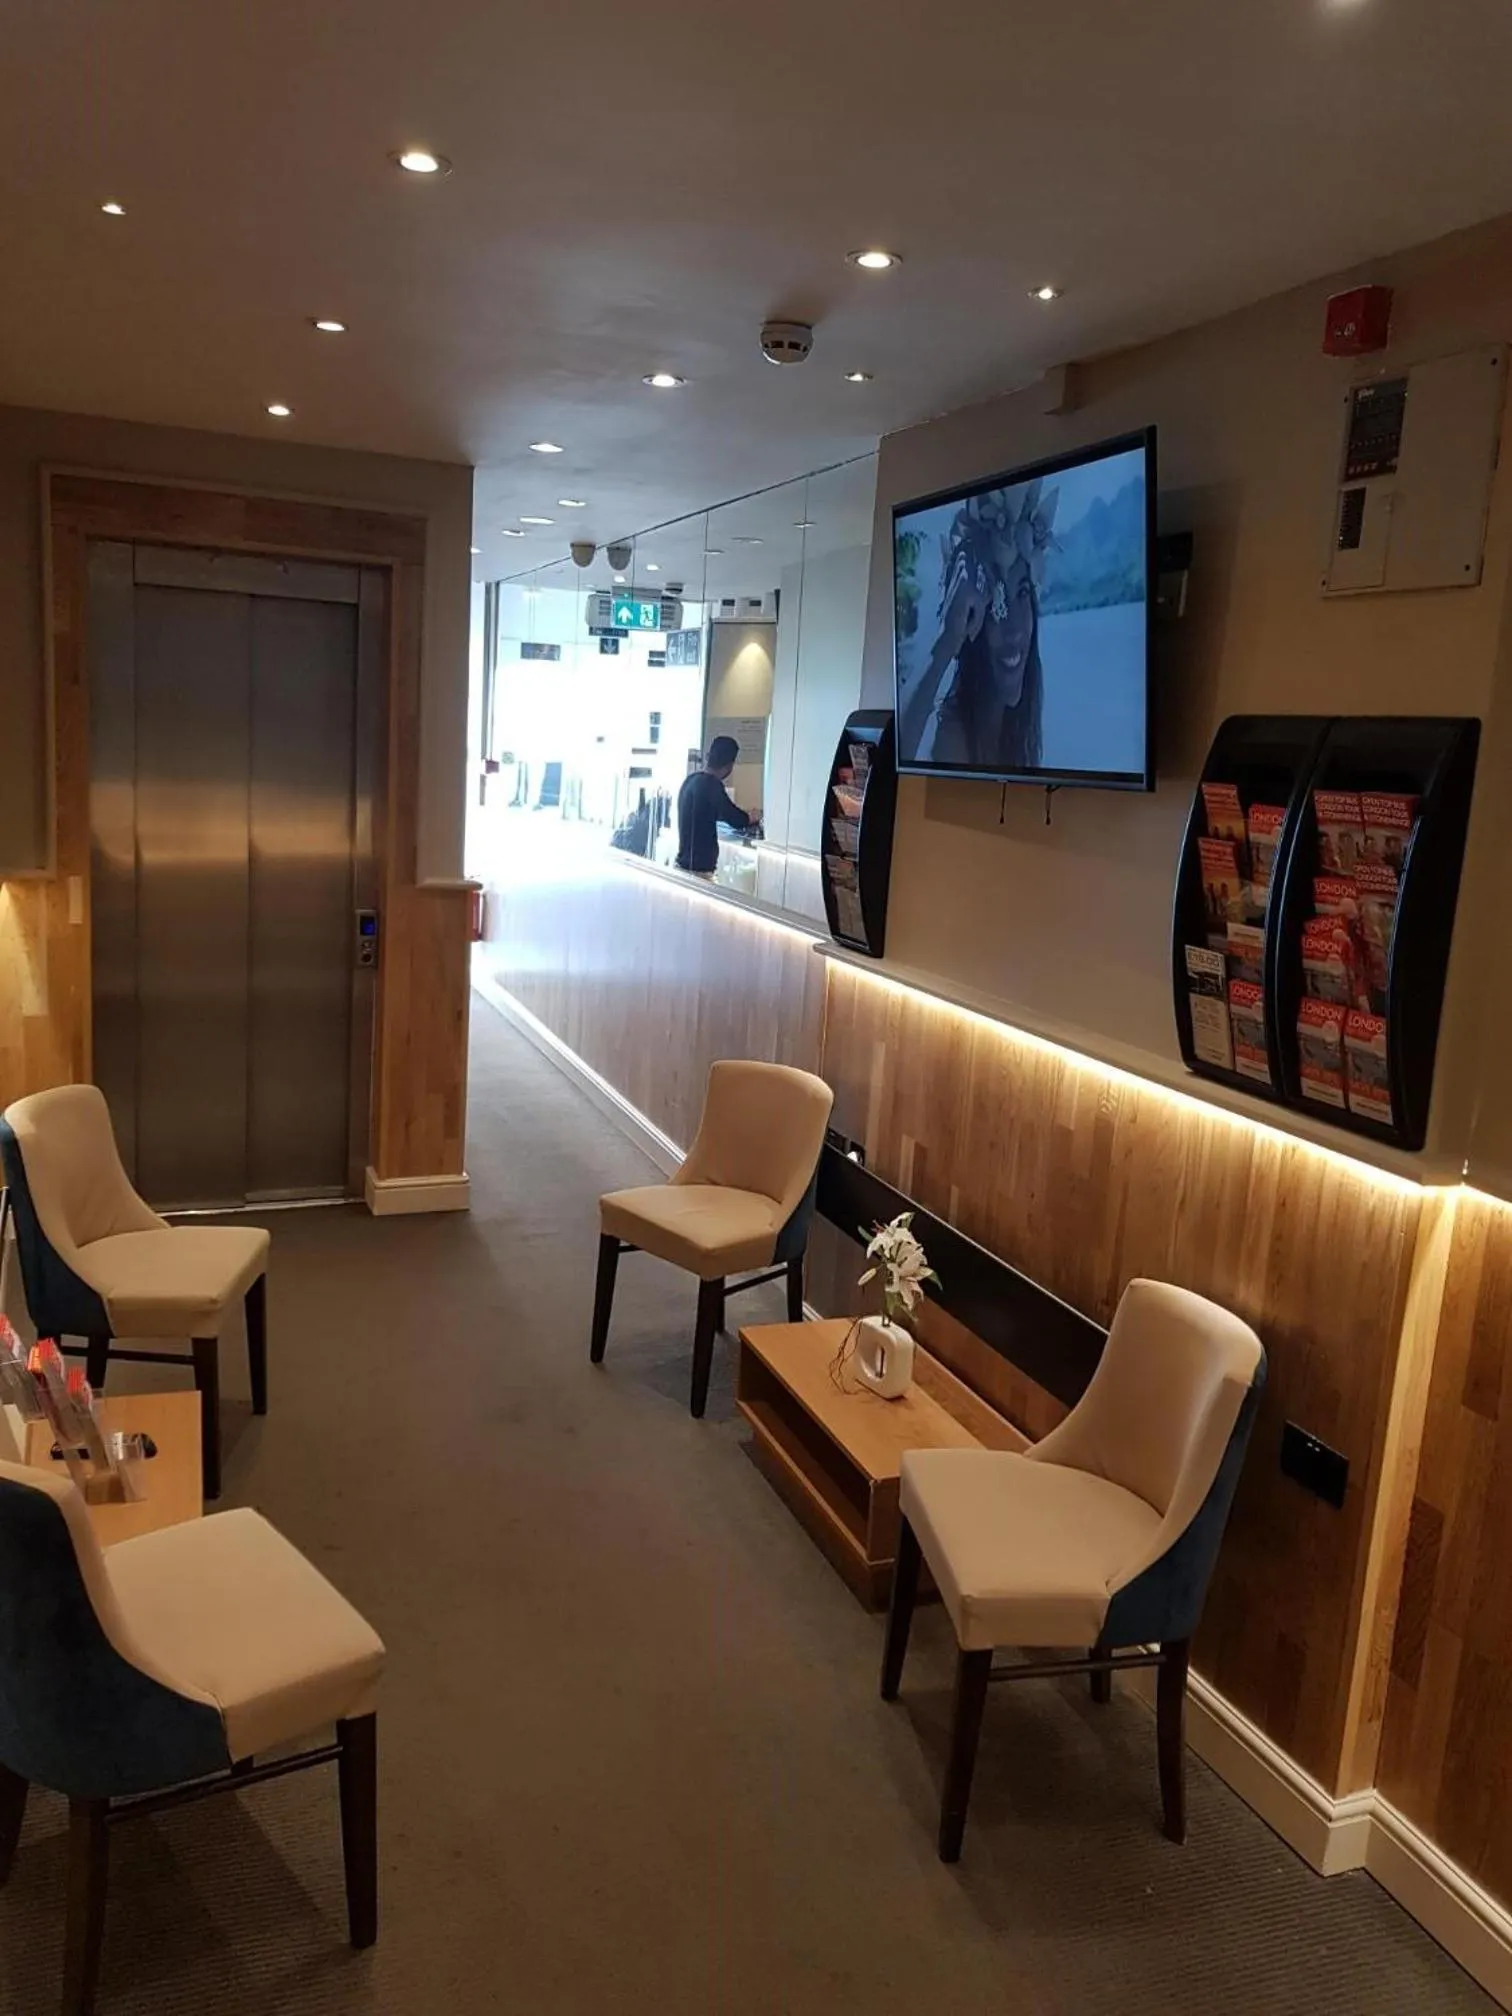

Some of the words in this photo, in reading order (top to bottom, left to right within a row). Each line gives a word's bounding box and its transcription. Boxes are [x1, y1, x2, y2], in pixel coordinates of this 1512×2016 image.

[1315, 881, 1357, 897] LONDON
[1303, 938, 1342, 953] LONDON
[1301, 1001, 1341, 1020] LONDON
[1348, 1013, 1385, 1033] LONDO
